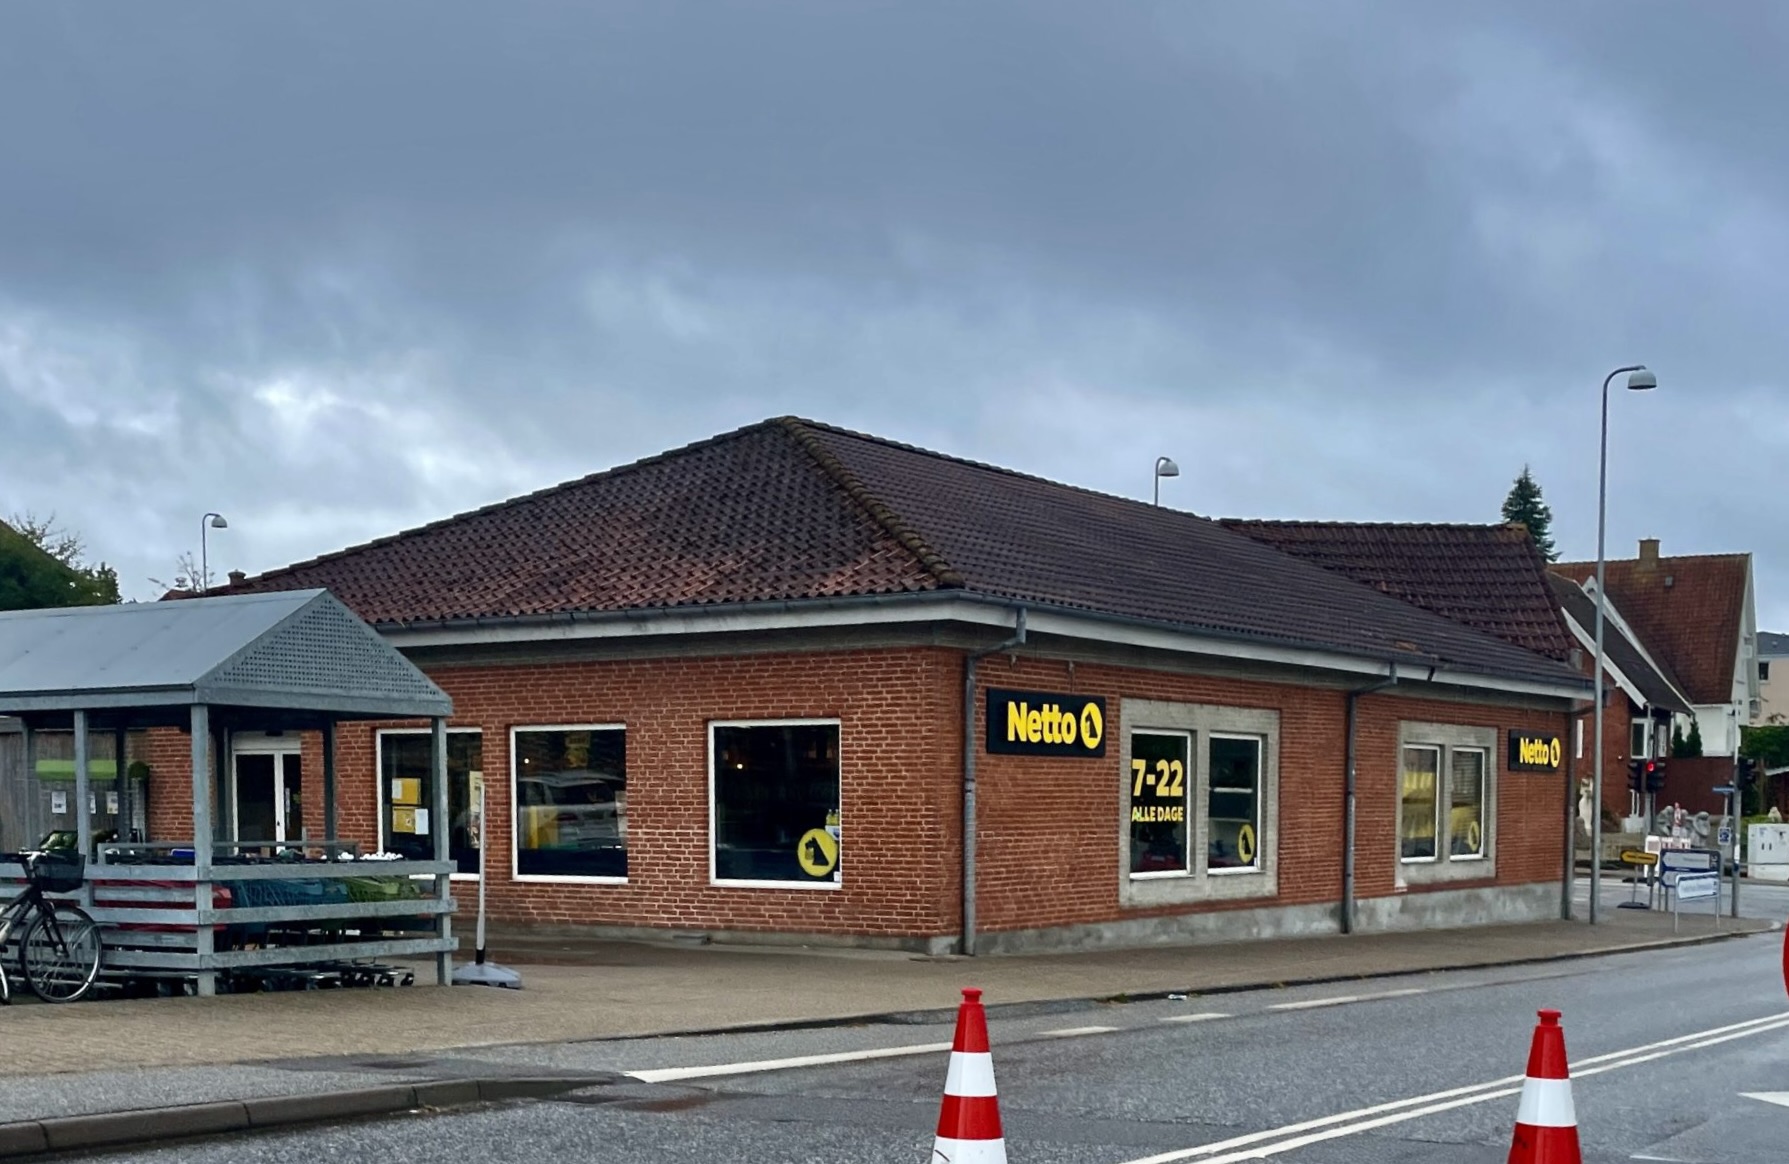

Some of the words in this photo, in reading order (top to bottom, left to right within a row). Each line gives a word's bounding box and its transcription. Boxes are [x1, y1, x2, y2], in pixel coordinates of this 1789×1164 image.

[1007, 701, 1077, 744] Netto
[1520, 737, 1549, 765] Netto
[1132, 758, 1183, 797] 7-22
[1131, 806, 1156, 822] ALLE
[1157, 806, 1183, 822] DAGE
